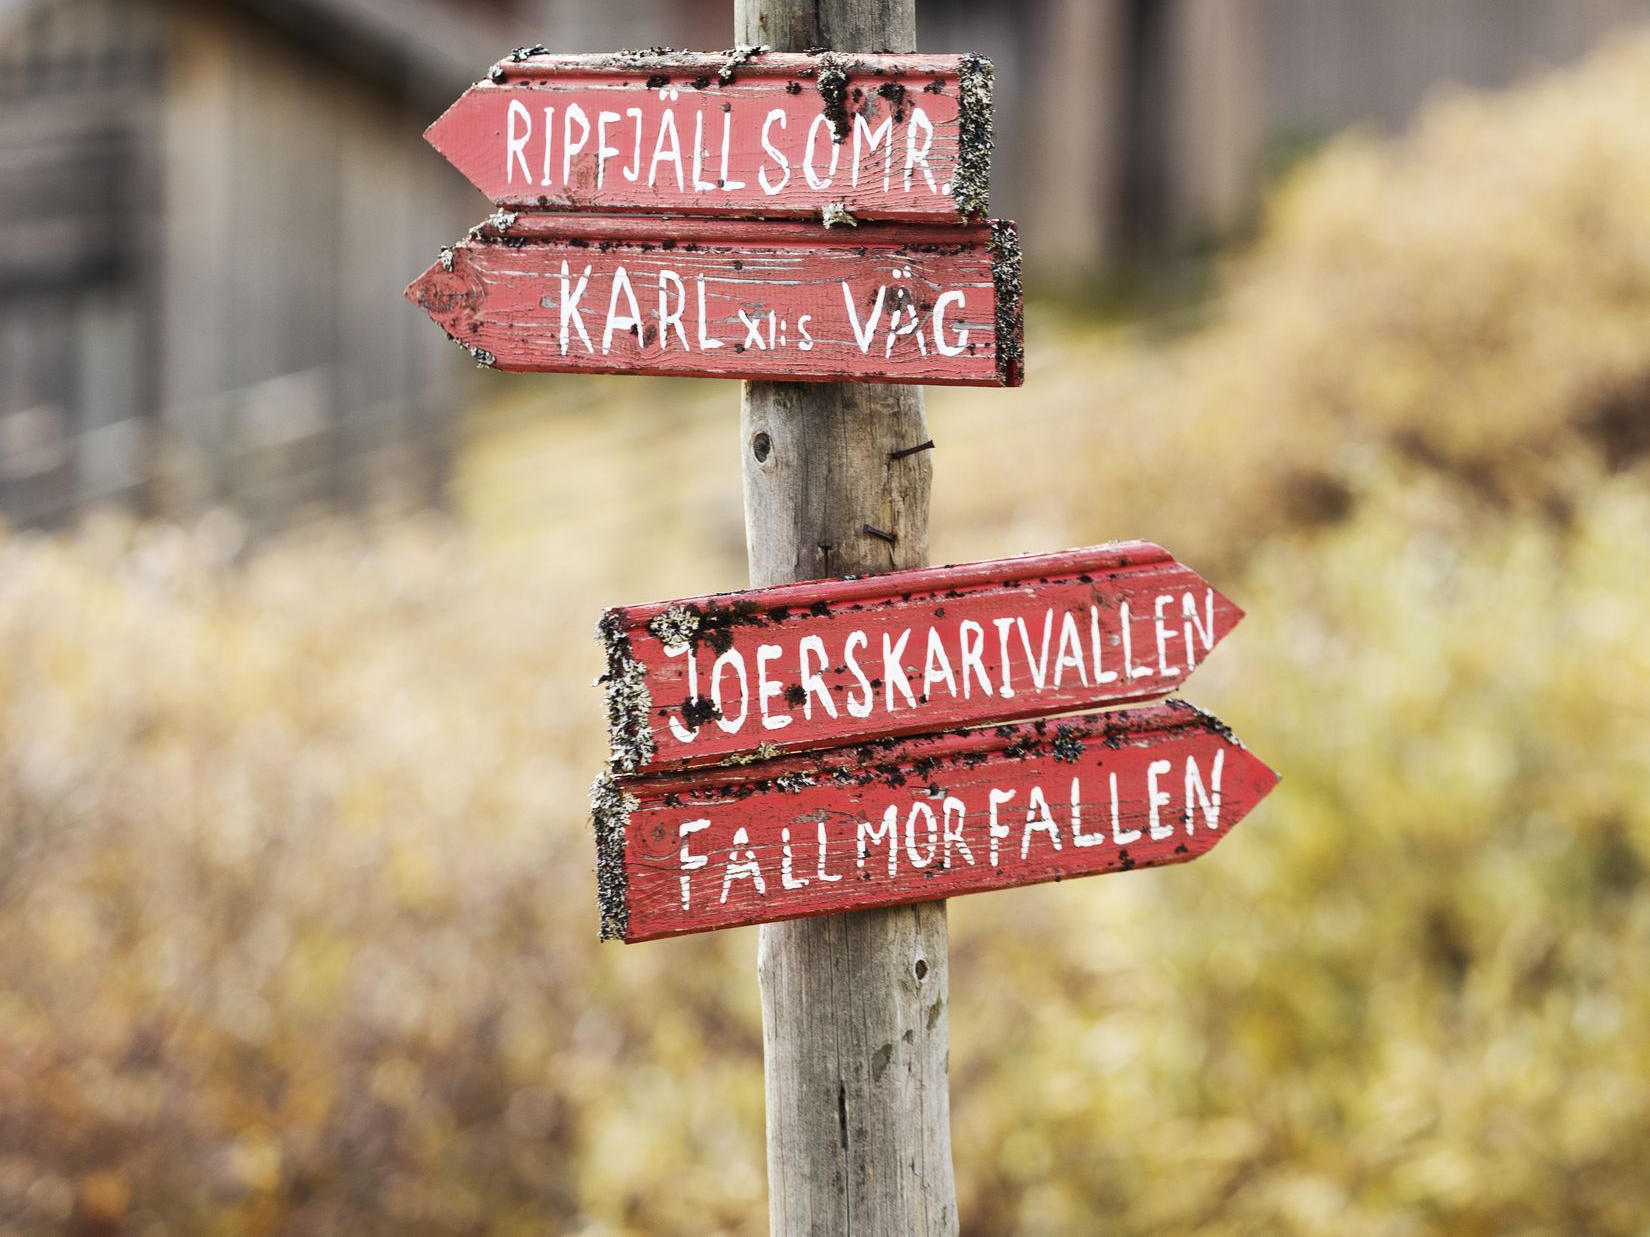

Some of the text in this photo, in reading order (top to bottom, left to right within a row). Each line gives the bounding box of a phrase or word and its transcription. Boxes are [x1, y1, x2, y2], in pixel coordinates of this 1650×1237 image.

[558, 260, 722, 357] KARL
[841, 266, 968, 359] VÄG
[664, 588, 1214, 742] JOERSKARIVALLEN
